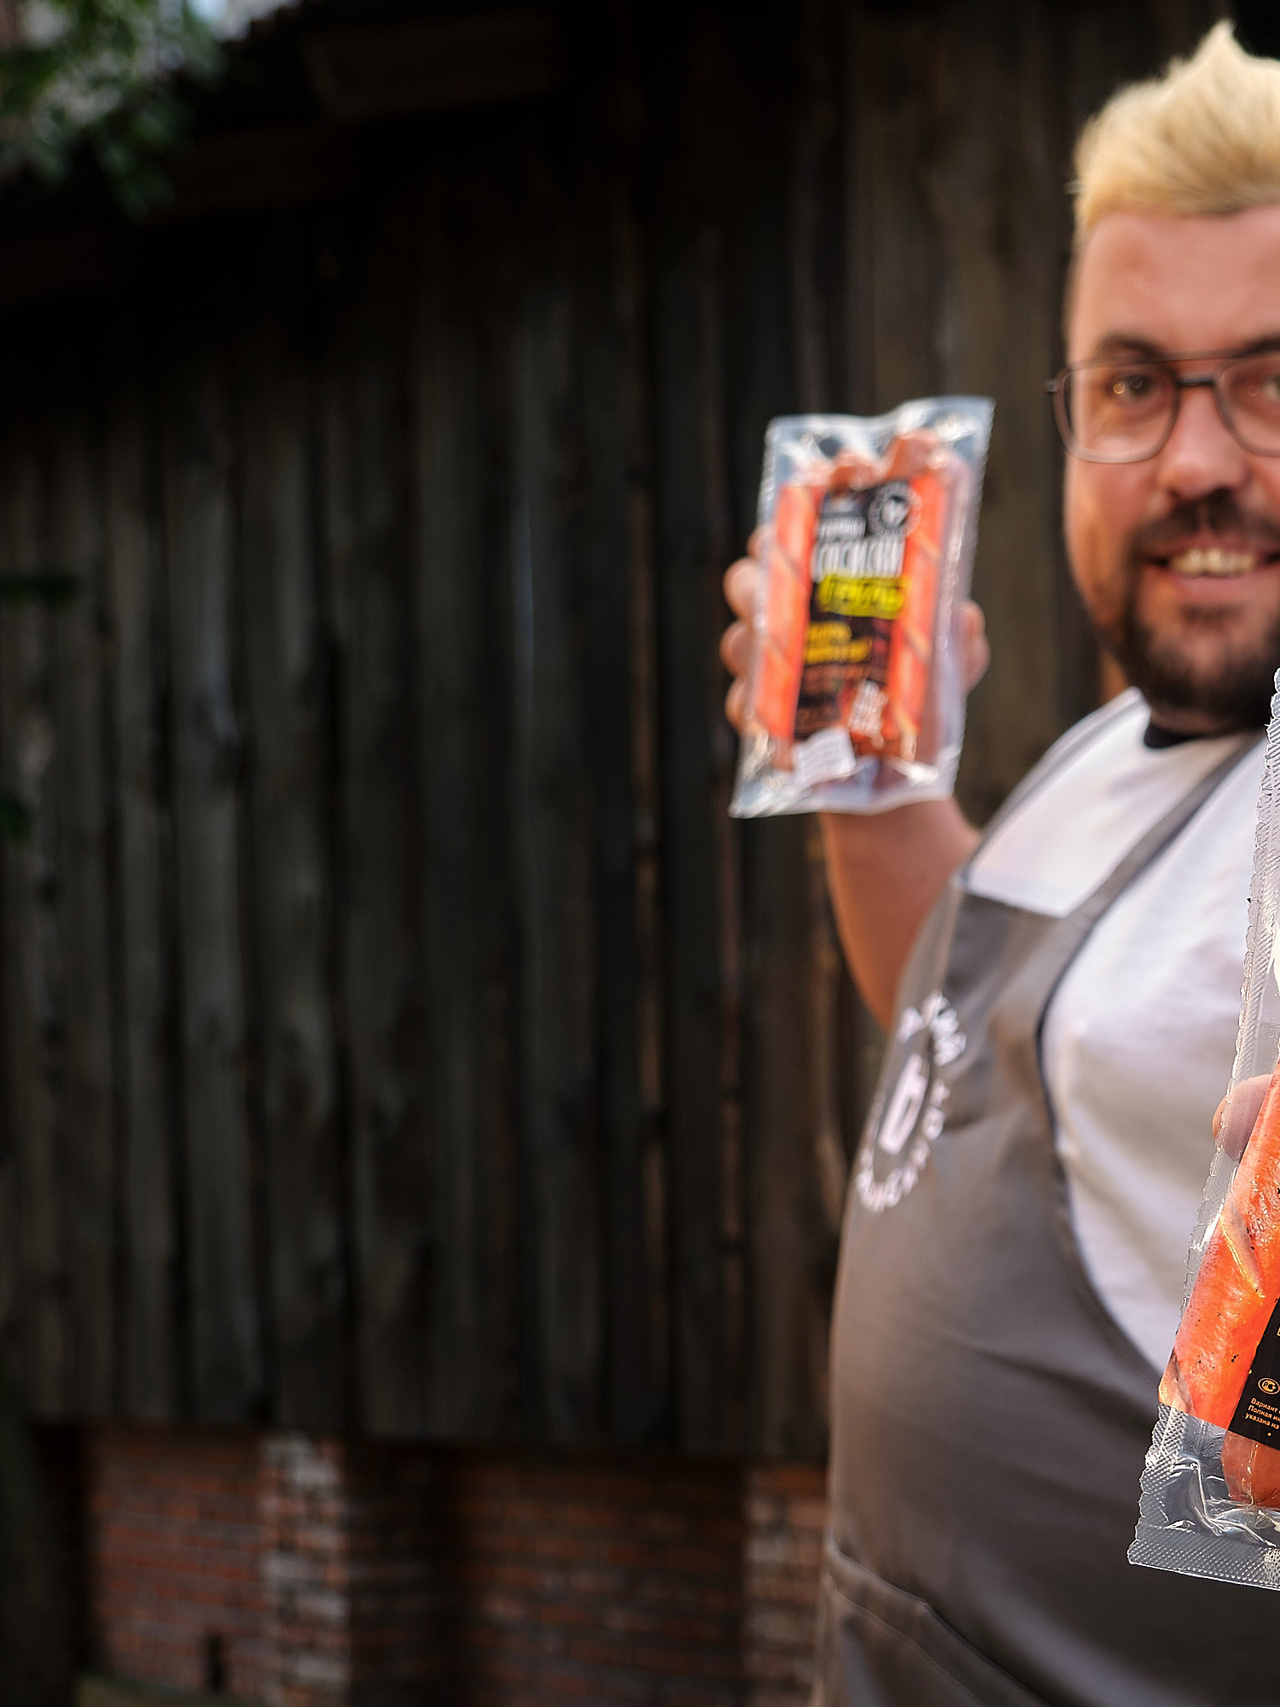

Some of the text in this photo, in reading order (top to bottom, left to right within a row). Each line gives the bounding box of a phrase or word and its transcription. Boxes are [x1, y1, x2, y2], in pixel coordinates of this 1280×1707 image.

[1248, 1404, 1273, 1419] Полная
[1250, 1397, 1278, 1413] Вариант
[1245, 1412, 1271, 1427] указана
